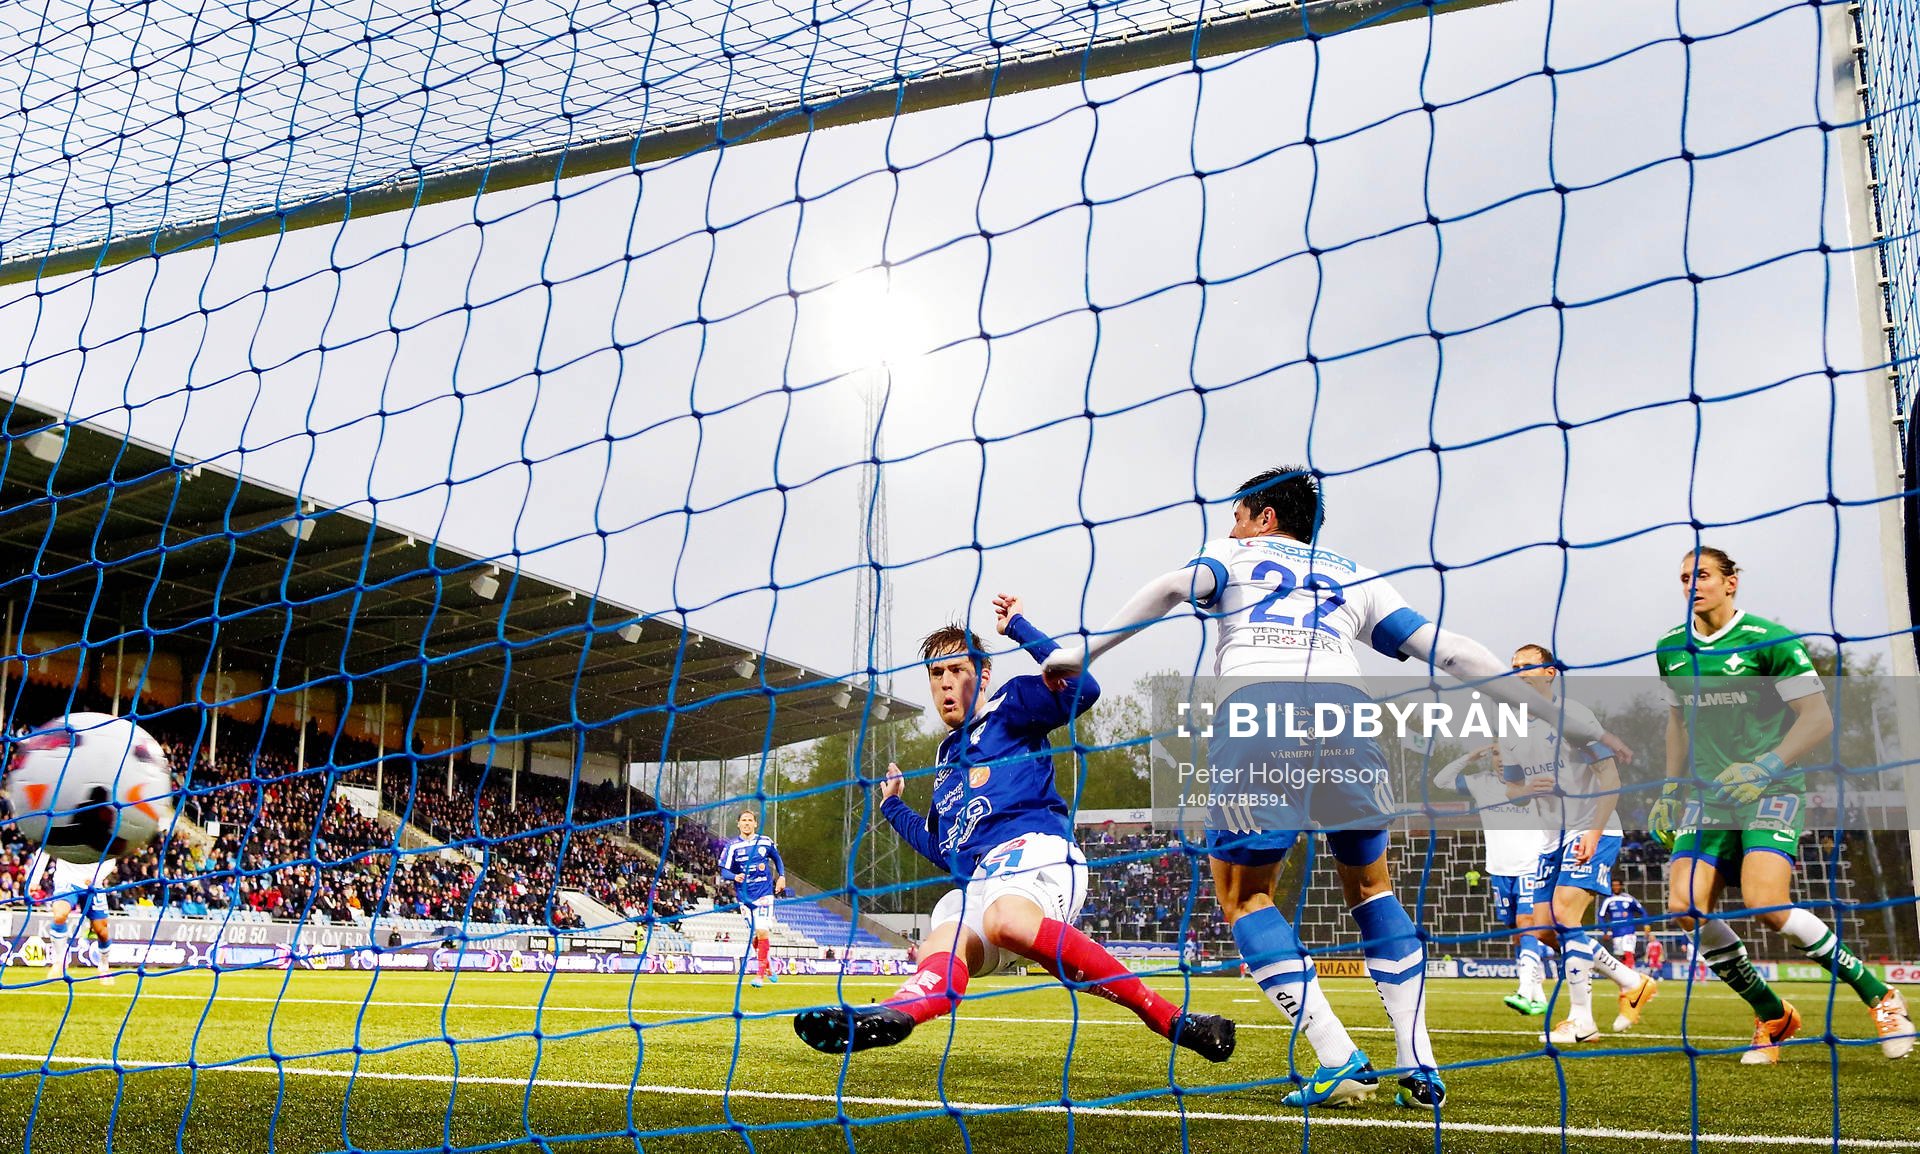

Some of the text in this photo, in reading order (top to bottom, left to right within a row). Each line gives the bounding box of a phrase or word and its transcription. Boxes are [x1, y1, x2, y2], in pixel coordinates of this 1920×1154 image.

[1249, 560, 1346, 639] 22
[1524, 760, 1565, 776] OLMEN
[177, 924, 267, 944] 011-2 08 50
[1315, 962, 1360, 975] MAN
[1462, 963, 1519, 977] Caver
